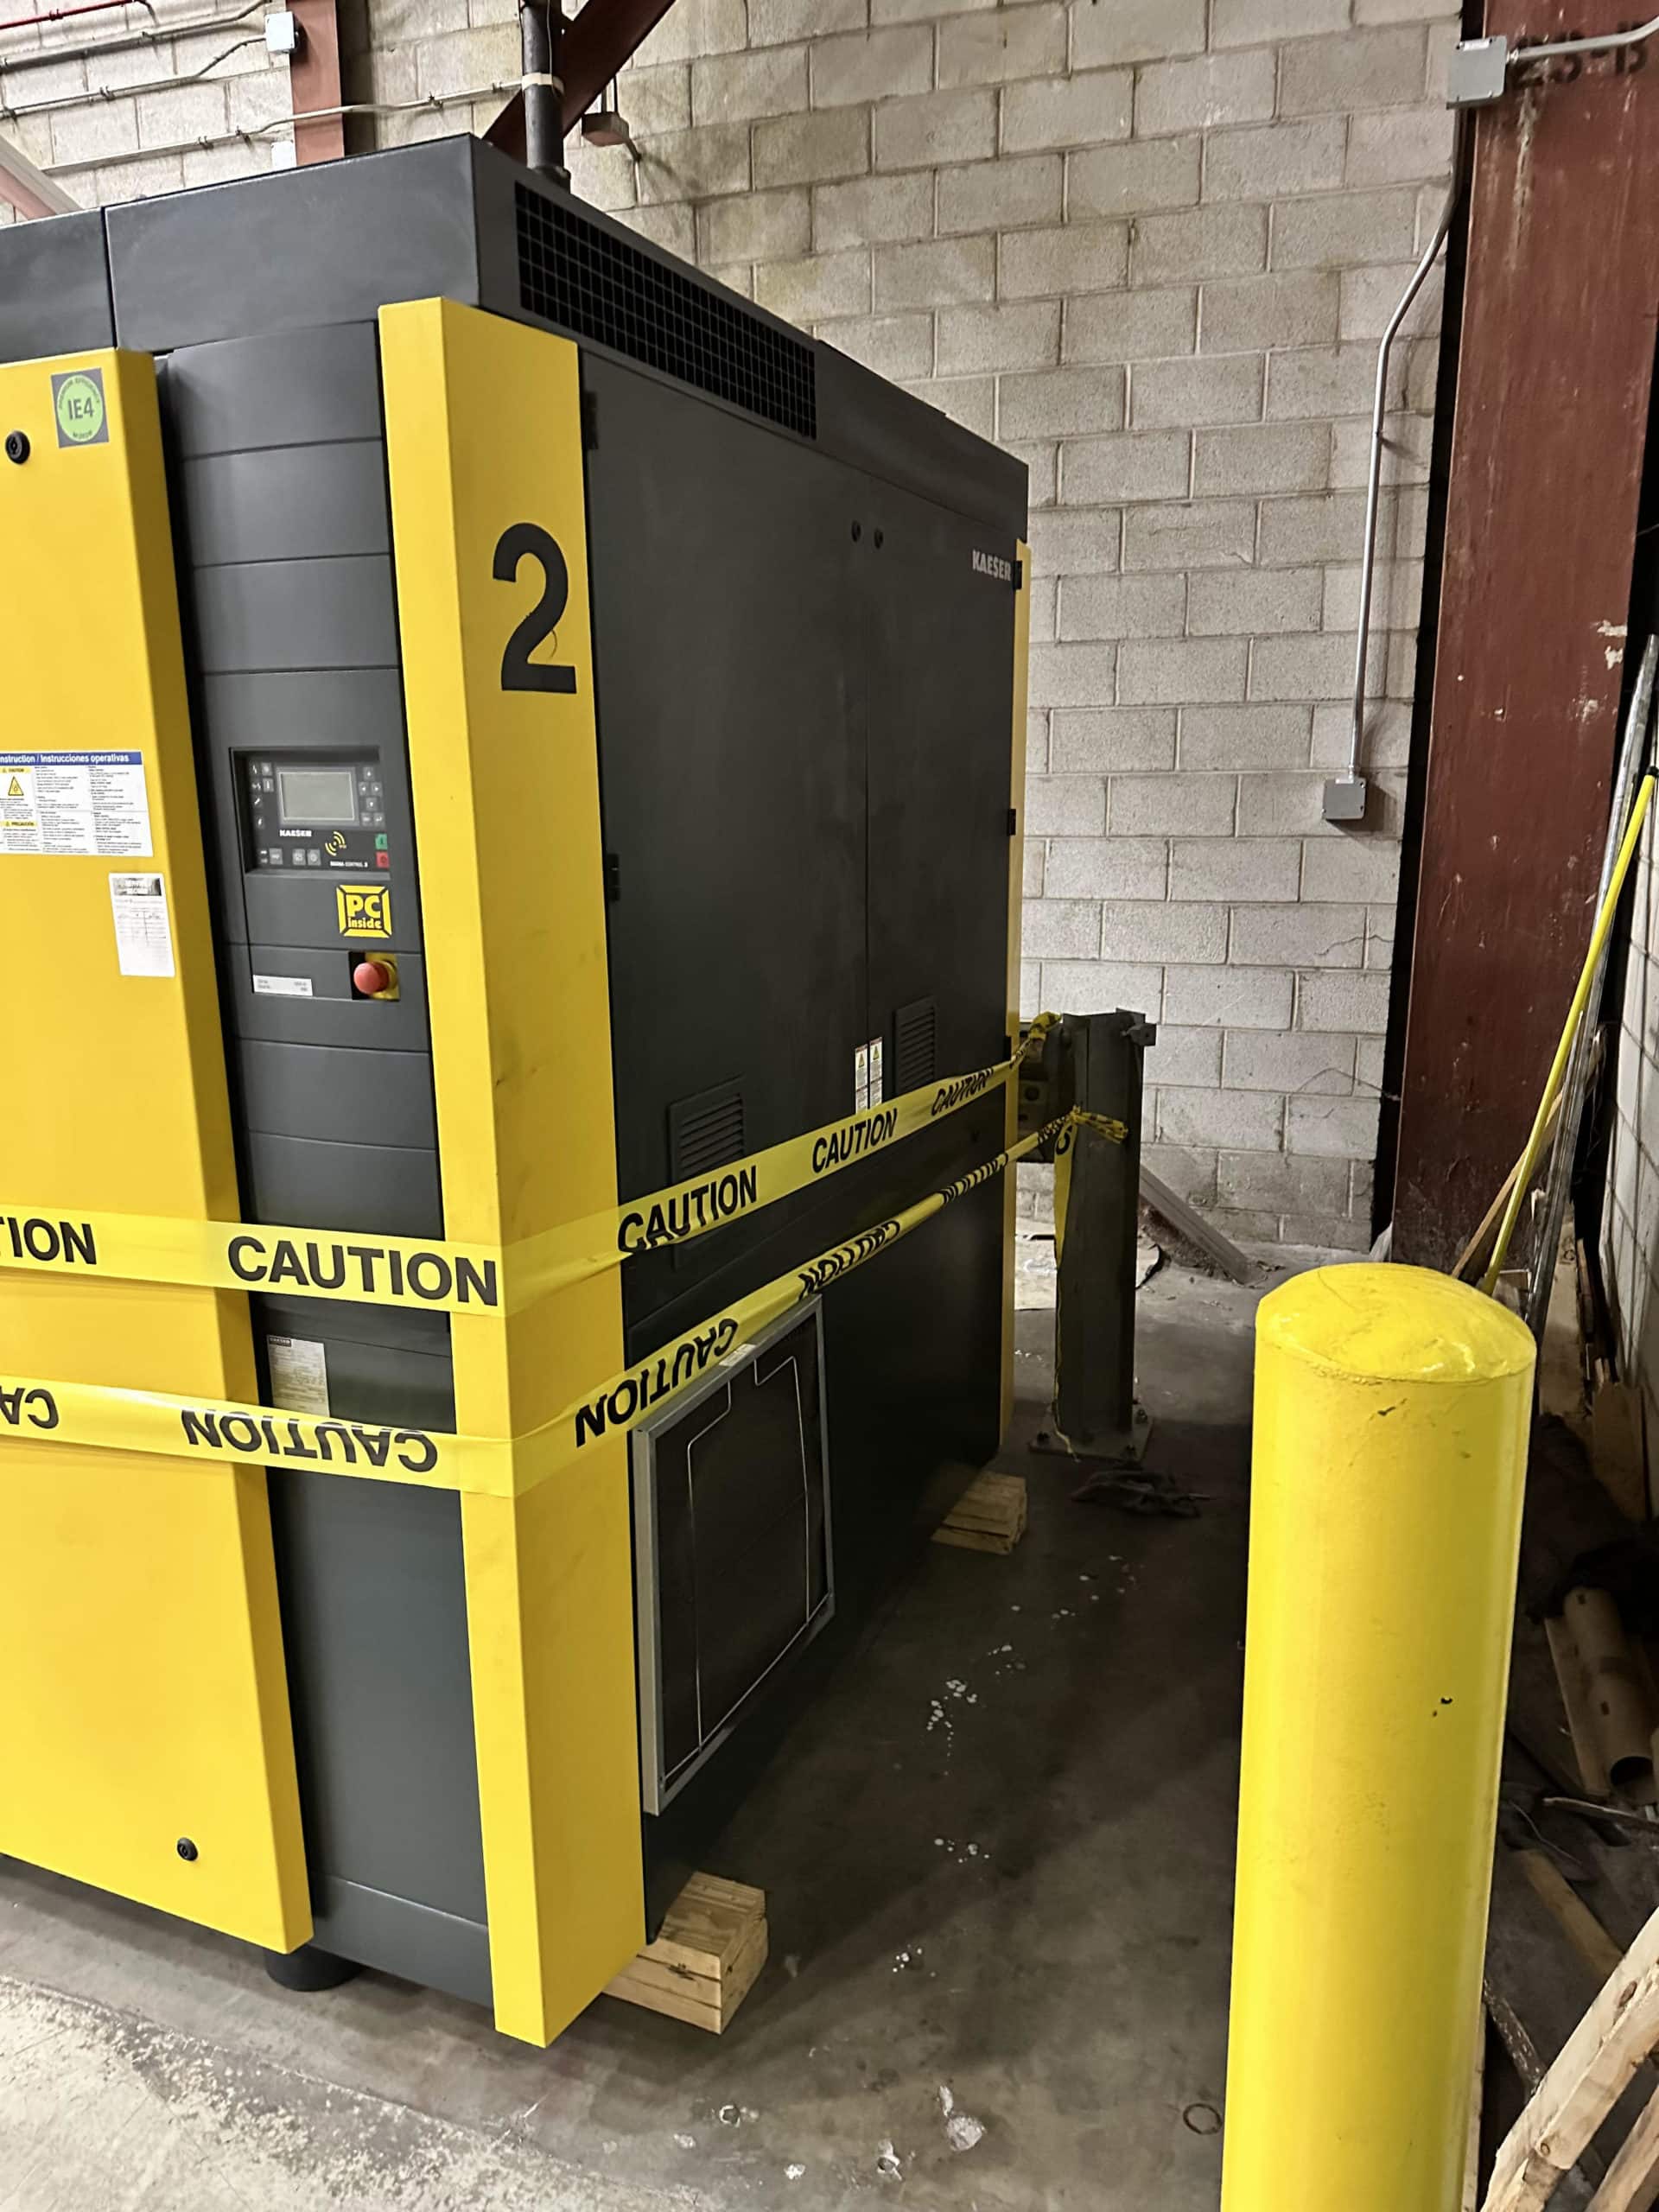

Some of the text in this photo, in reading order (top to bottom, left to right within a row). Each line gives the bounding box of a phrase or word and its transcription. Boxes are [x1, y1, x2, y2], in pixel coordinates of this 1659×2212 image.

[67, 397, 94, 420] IE4
[972, 550, 1011, 581] KAESER
[493, 522, 577, 694] 2
[41, 753, 89, 763] Instrucciones
[91, 753, 130, 764] operativas
[346, 893, 381, 918] PC
[347, 917, 382, 929] inside
[931, 1067, 994, 1116] CAUTION
[812, 1108, 898, 1173] CAUTION
[617, 1166, 758, 1254] CAUTION
[227, 1236, 498, 1306] CAUTION
[575, 1318, 739, 1448] CAUTION
[181, 1408, 437, 1472] CAUTION
